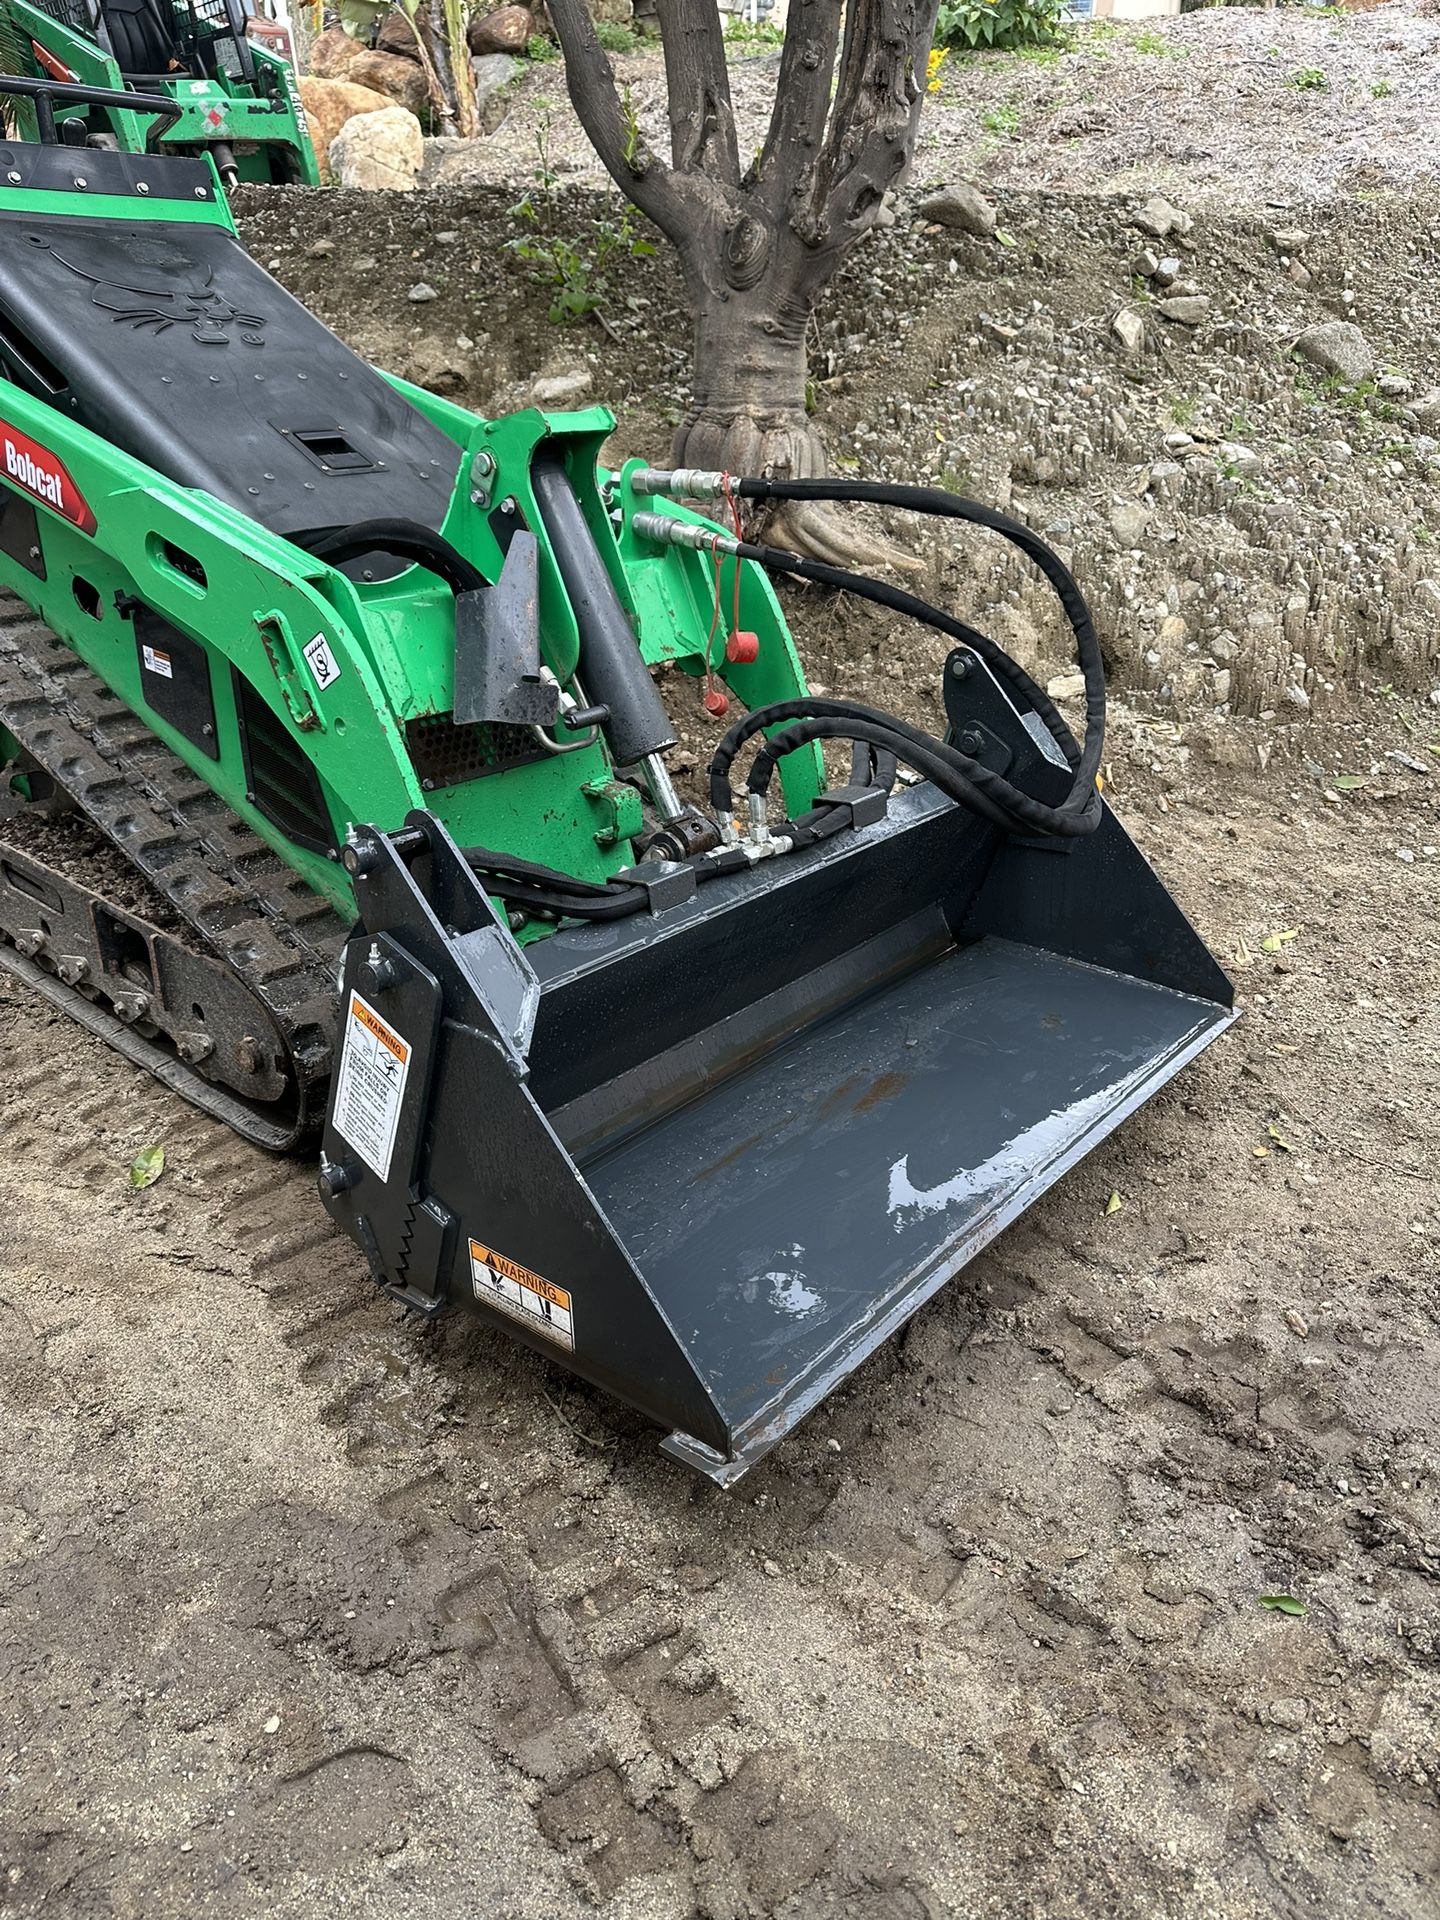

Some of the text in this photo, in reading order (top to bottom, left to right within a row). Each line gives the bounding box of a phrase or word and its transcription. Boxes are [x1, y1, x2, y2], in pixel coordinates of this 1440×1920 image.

[5, 438, 64, 509] Bobcat
[366, 1016, 402, 1055] WARNING
[497, 1258, 557, 1301] WARNING
